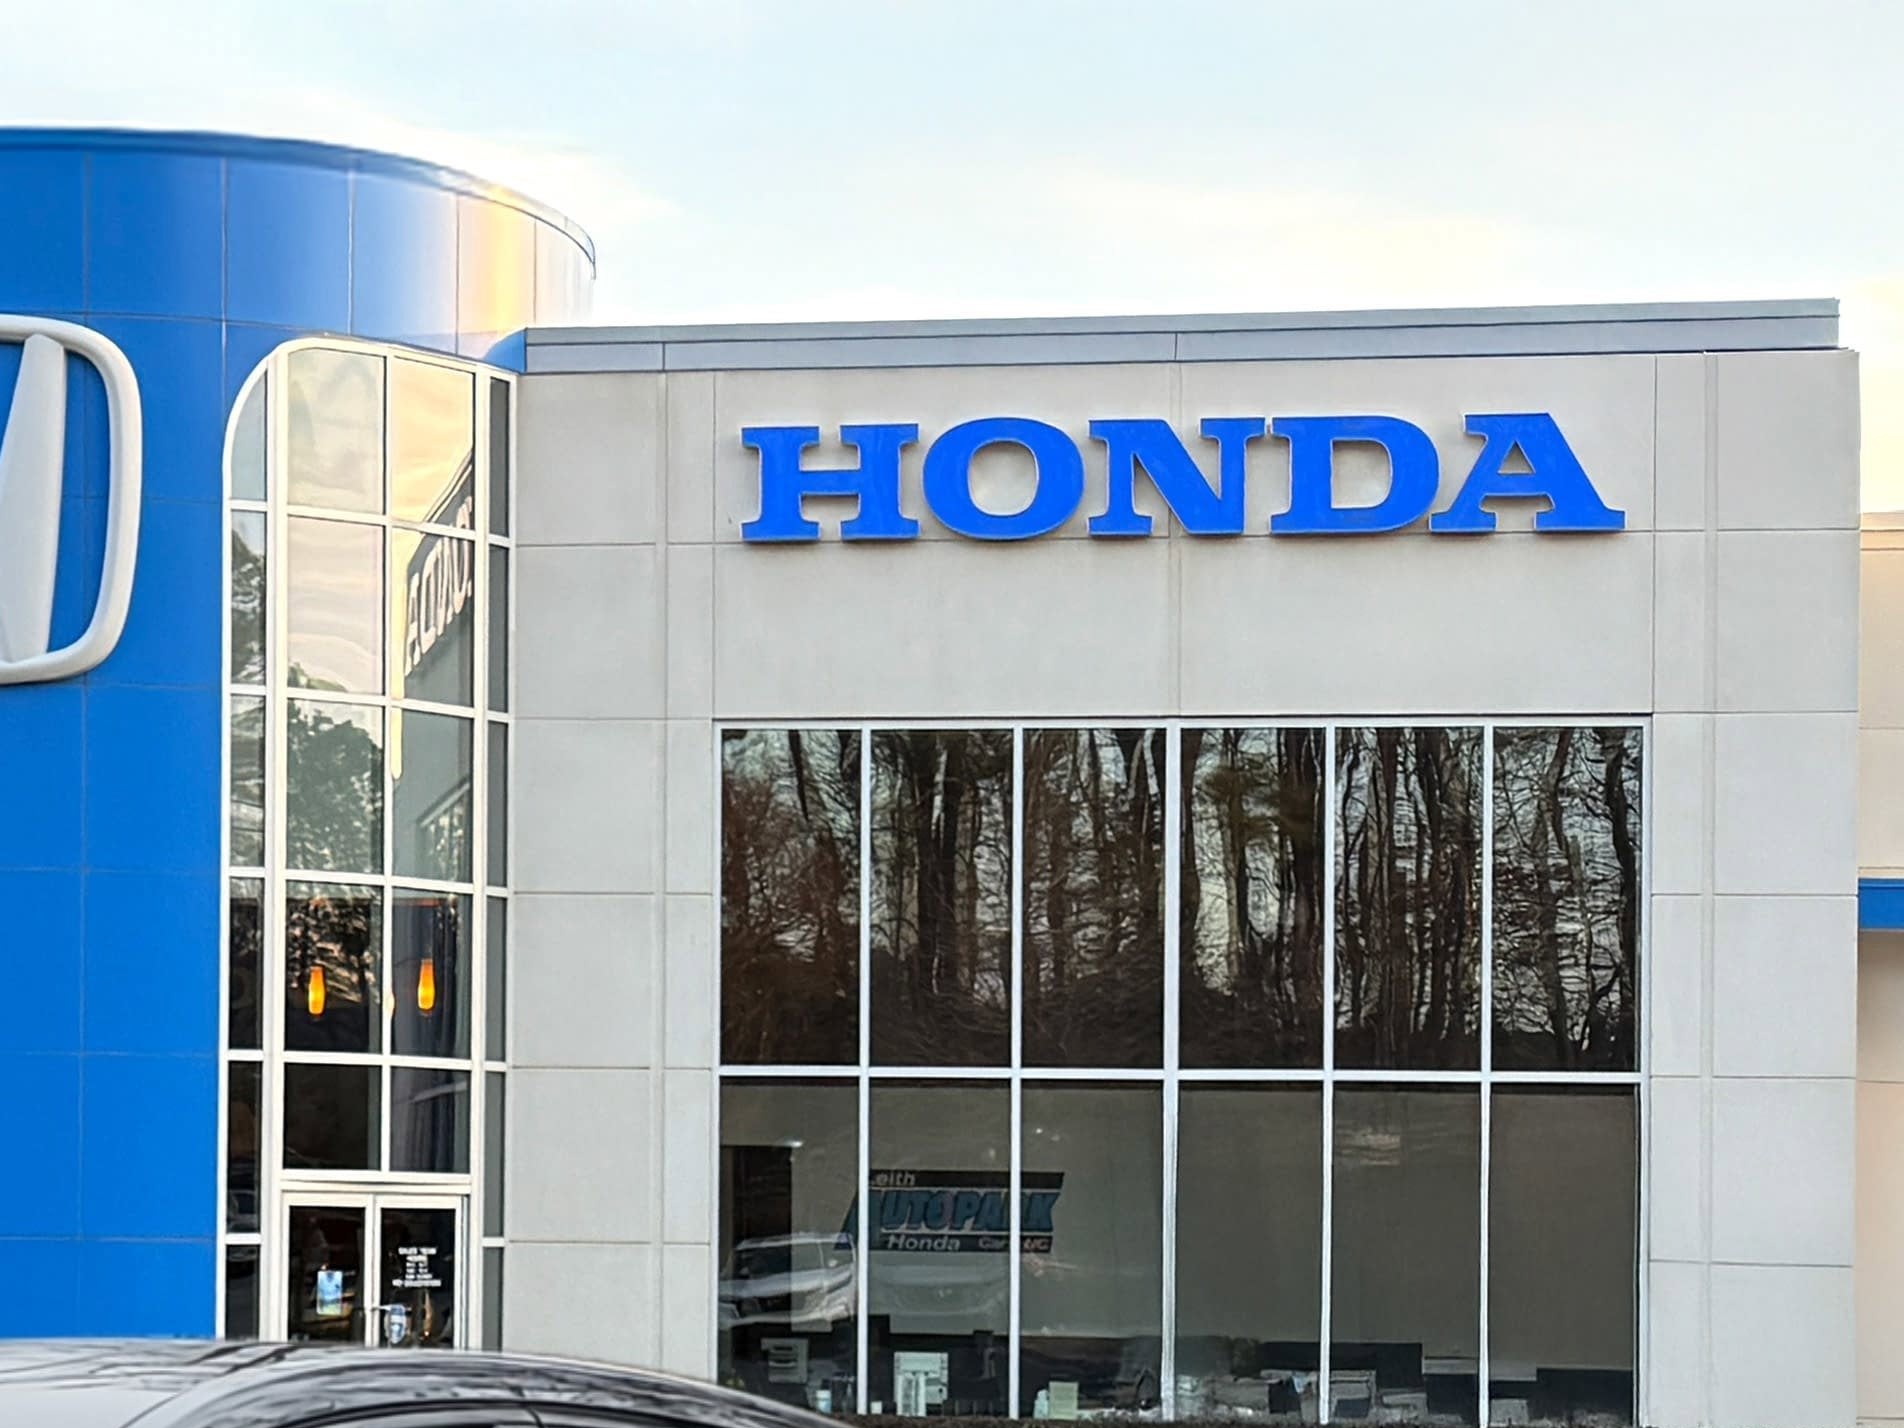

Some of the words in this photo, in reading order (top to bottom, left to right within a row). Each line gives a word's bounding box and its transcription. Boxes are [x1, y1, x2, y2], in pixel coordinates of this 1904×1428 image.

[740, 412, 1626, 542] HONDA
[872, 1172, 915, 1186] eith
[886, 1235, 960, 1251] Honda
